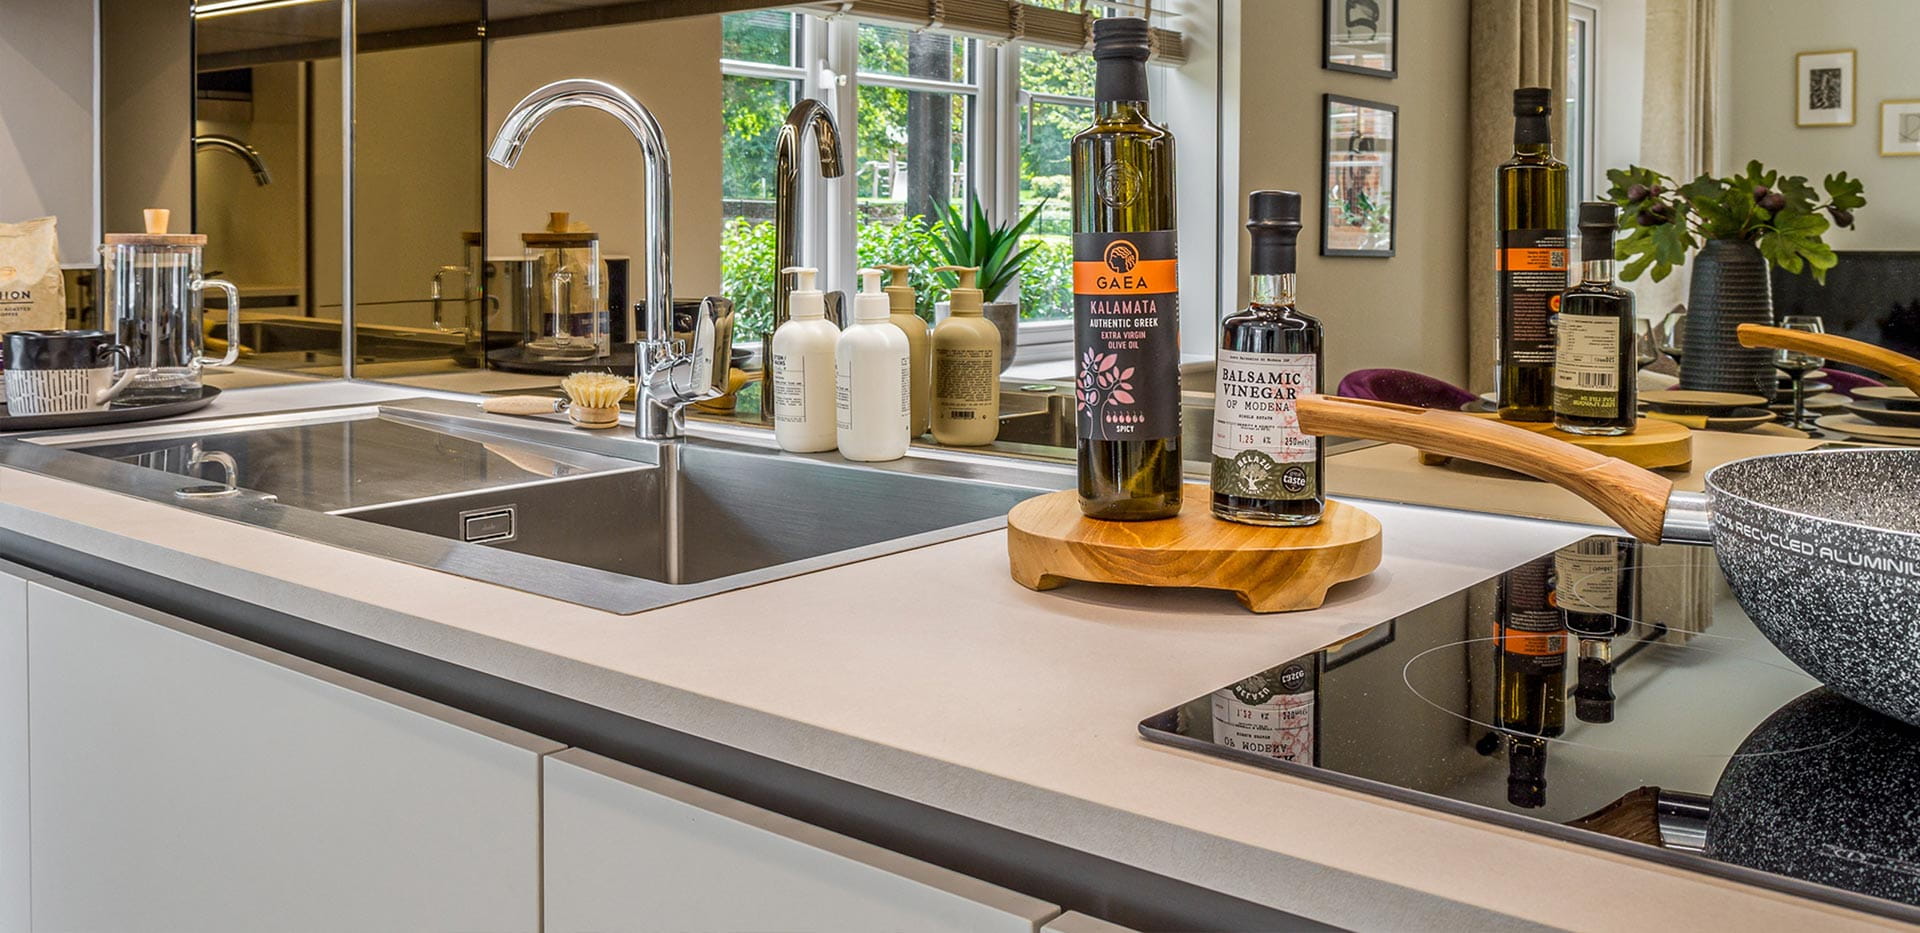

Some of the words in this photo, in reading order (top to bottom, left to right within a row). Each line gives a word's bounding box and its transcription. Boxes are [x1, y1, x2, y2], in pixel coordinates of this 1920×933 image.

[1096, 276, 1148, 289] GAEA
[0, 290, 31, 300] ION
[1090, 300, 1157, 314] KALAMATA
[1089, 319, 1131, 328] AUTHENTIC
[1134, 318, 1159, 327] GREEK
[1101, 331, 1121, 339] EXTRA
[1123, 331, 1146, 339] VIRGIN
[1108, 341, 1127, 349] OLIVE
[1129, 341, 1139, 349] OIL
[1222, 368, 1301, 385] BALSAMIC
[1223, 383, 1297, 399] VINEGAR
[1226, 400, 1238, 409] OF
[1244, 401, 1290, 411] MODENA
[1116, 425, 1134, 433] SPICY
[1239, 434, 1254, 444] 1.25
[1237, 456, 1272, 470] BELAZU
[1735, 521, 1814, 556] RECYCLED
